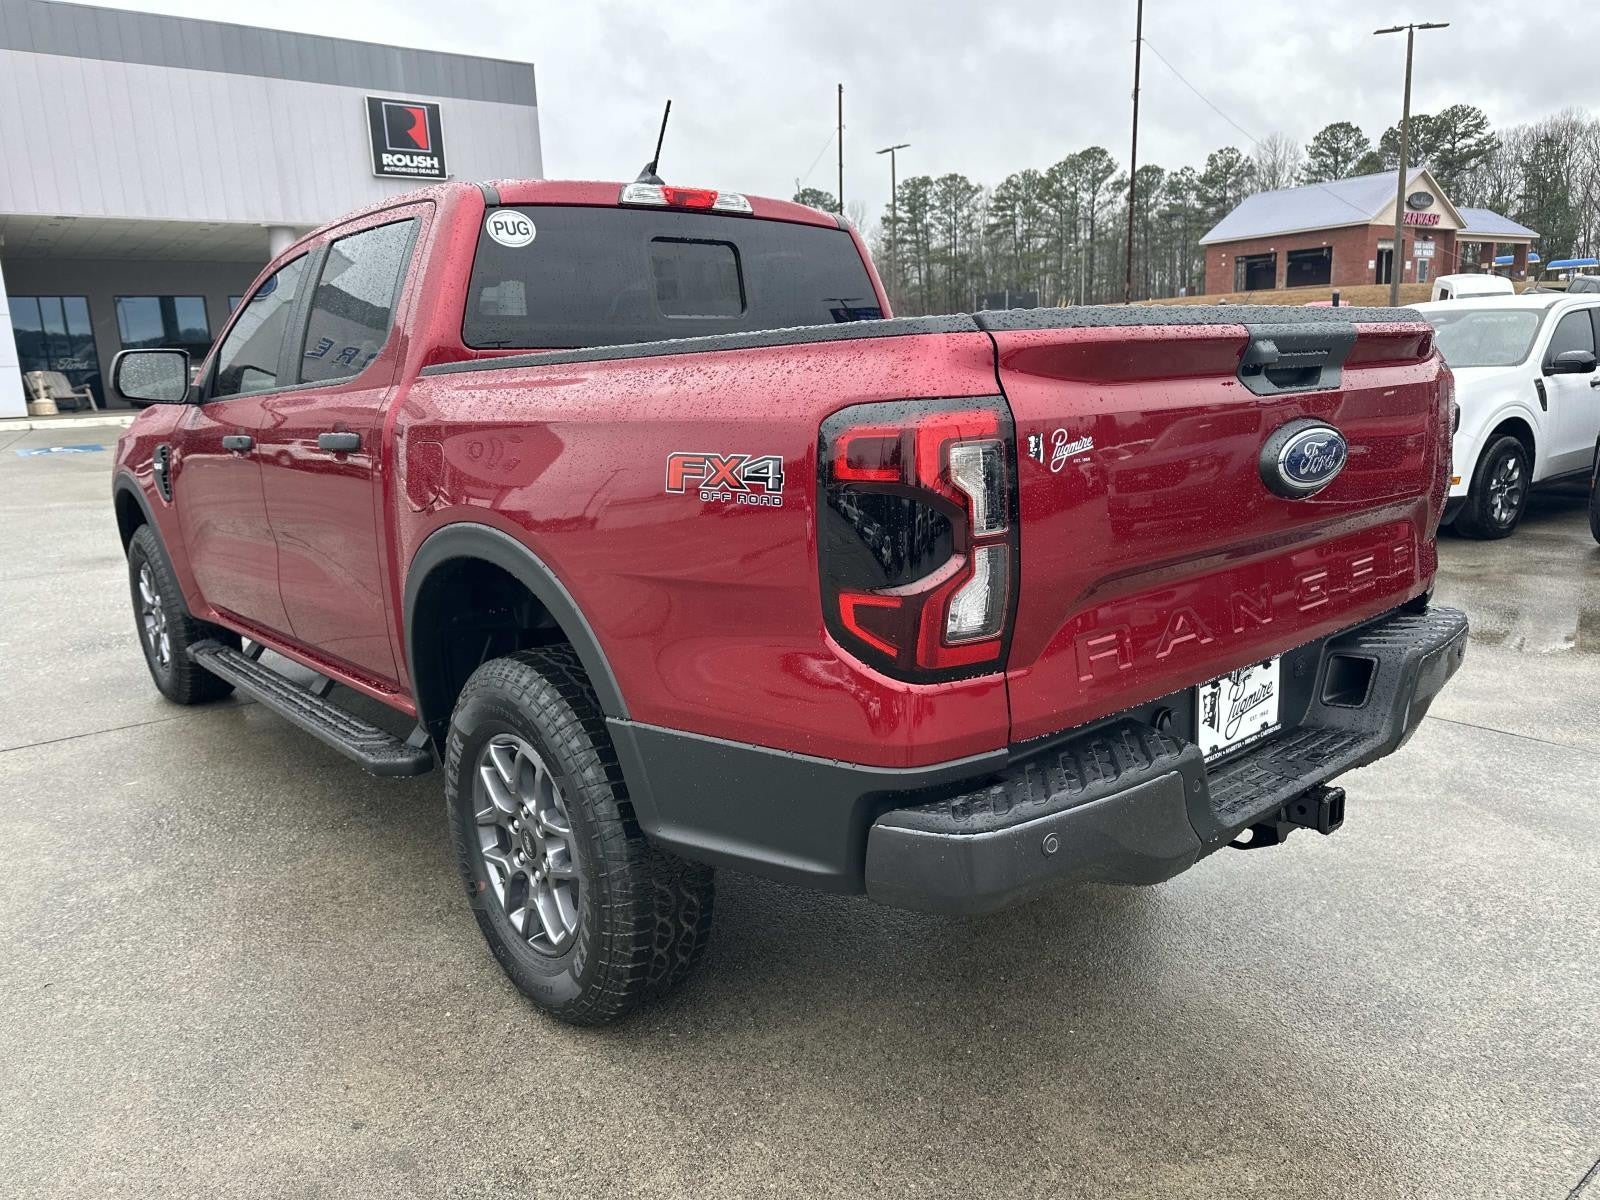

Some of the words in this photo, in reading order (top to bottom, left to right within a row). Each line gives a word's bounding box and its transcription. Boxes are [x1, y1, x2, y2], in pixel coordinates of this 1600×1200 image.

[382, 153, 439, 168] ROUSH
[384, 166, 418, 174] AUTHORIZED
[493, 220, 530, 236] PUG
[56, 357, 89, 370] Ford
[1050, 428, 1095, 473] Pugmire
[1299, 441, 1337, 475] Ford
[665, 451, 785, 495] FX4
[699, 491, 732, 503] OFF
[736, 493, 783, 507] ROAD
[1074, 539, 1413, 684] RANGER
[1225, 680, 1274, 740] Pugmire
